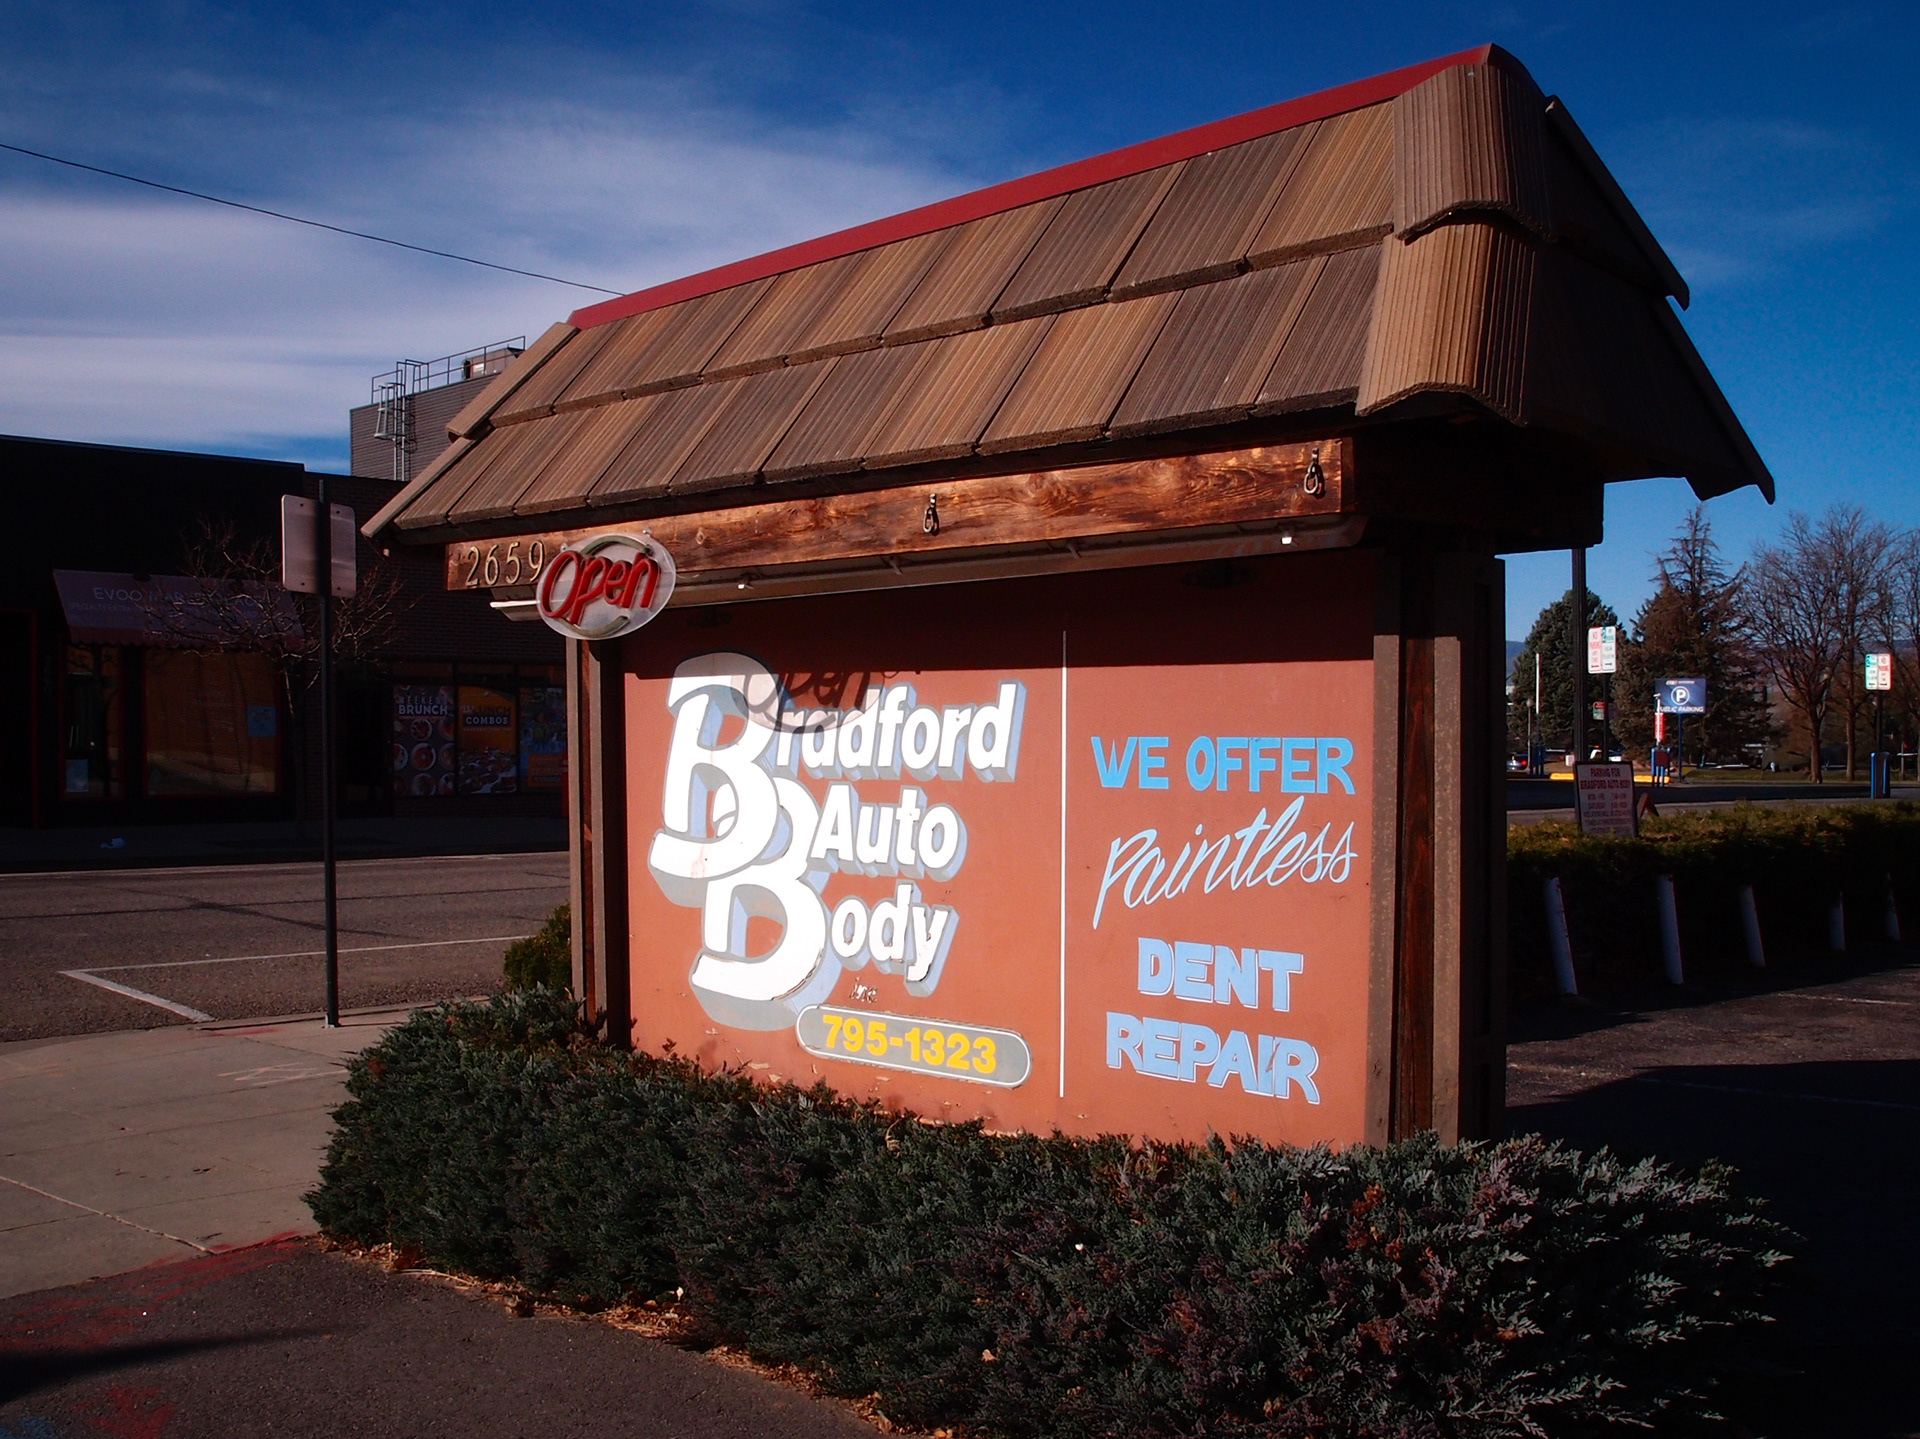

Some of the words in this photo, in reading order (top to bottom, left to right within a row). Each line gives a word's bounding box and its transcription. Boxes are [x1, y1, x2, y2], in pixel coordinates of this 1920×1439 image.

[465, 539, 545, 587] 2659
[540, 550, 661, 625] Open
[93, 587, 143, 602] EVOO
[399, 704, 448, 715] BRUNCH
[466, 716, 508, 725] COMBOS
[649, 652, 1026, 880] Bradford
[1091, 736, 1169, 789] WE
[1185, 735, 1356, 795] OFFER
[1580, 779, 1606, 790] BRADFORD
[1607, 779, 1619, 789] AUTO
[1620, 779, 1630, 789] BODY
[1590, 767, 1611, 777] PARKING
[1611, 767, 1621, 777] FOR
[810, 783, 966, 880] Auto
[690, 778, 958, 1005] Body
[1092, 795, 1358, 930] Paintless
[1137, 936, 1304, 1012] DENT
[822, 1013, 996, 1074] 795-1323
[1106, 1011, 1320, 1104] REPAIR
